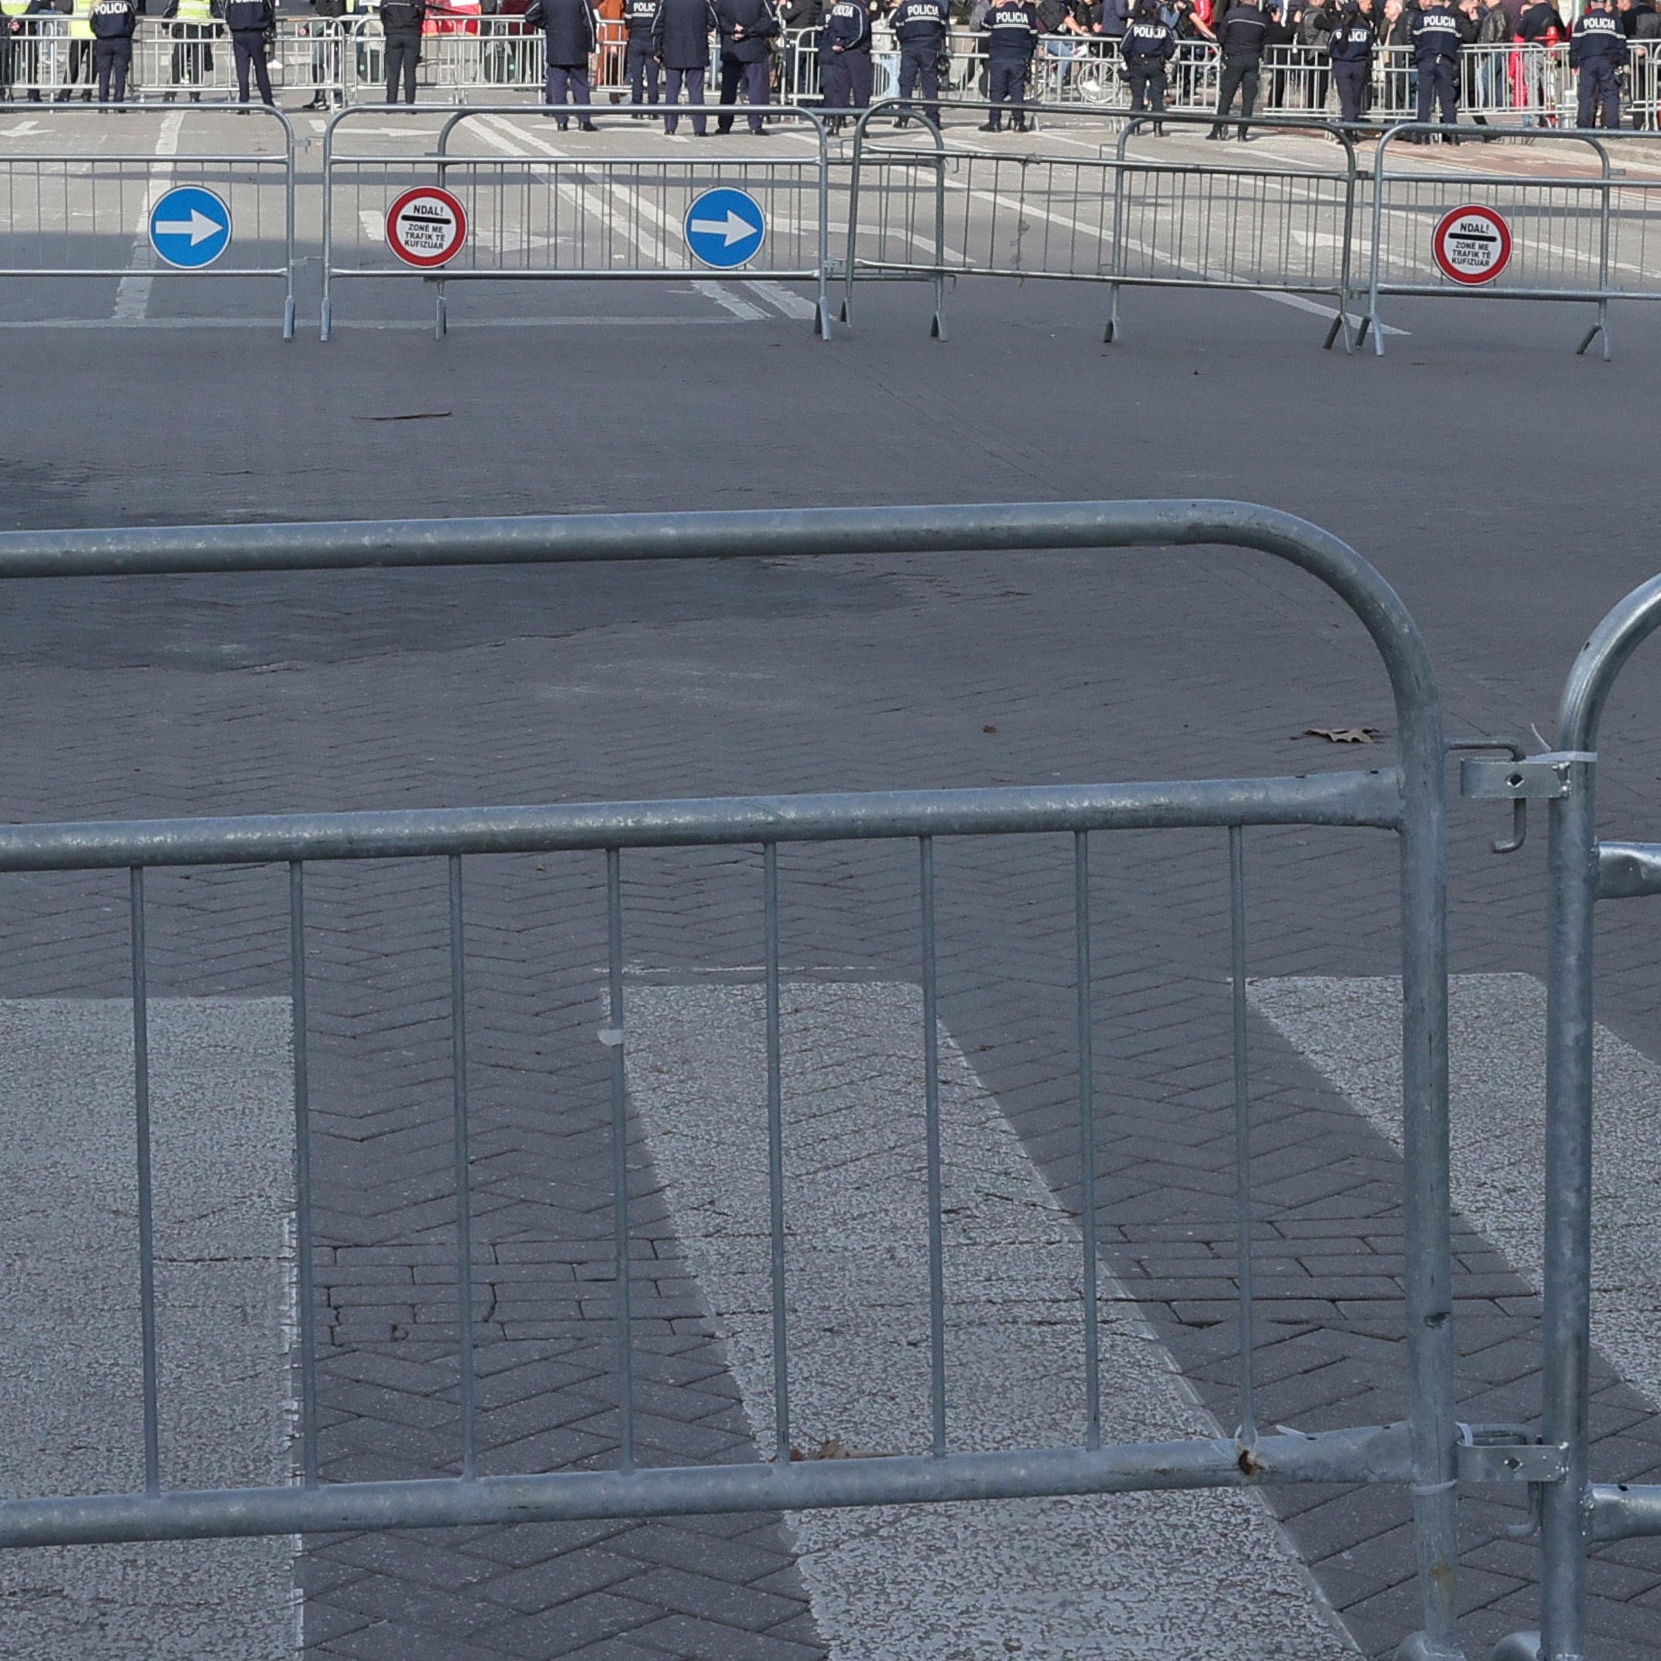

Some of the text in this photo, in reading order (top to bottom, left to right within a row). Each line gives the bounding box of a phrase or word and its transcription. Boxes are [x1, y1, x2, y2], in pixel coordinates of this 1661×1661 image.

[95, 2, 128, 15] POLICIA
[633, 2, 656, 12] POLIC
[907, 4, 939, 17] POLICIA
[996, 12, 1028, 24] POLICIA
[1423, 16, 1456, 29] POLICIA
[1583, 18, 1615, 31] POLICIA
[413, 205, 444, 216] NDAL!
[408, 223, 429, 232] ZONË
[1460, 223, 1489, 234] NDAL!
[405, 231, 445, 242] TRAFIK TË
[404, 240, 444, 249] KUFIZUAR
[1455, 241, 1476, 250] ZONË
[1452, 249, 1491, 259] TRAFIK TË
[1451, 258, 1490, 267] KUFIZUAR
